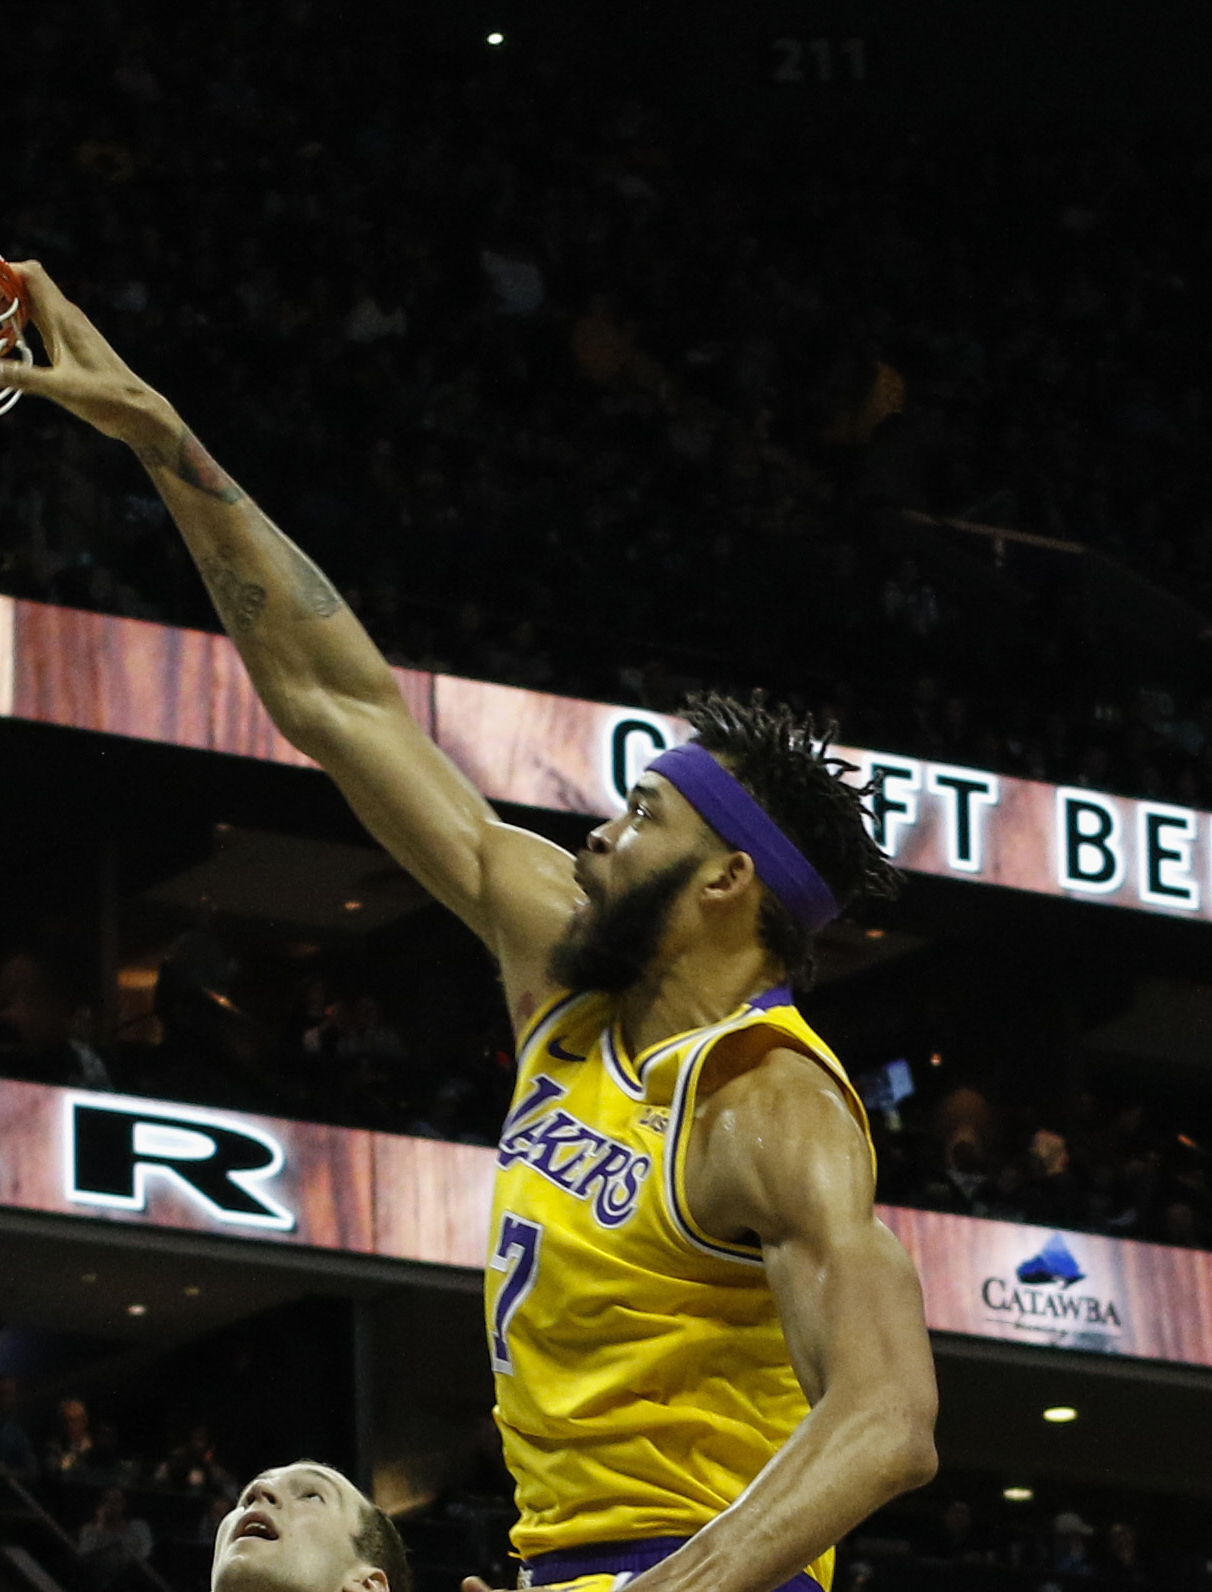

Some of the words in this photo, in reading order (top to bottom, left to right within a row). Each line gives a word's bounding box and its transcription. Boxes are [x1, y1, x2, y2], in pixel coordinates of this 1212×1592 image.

[771, 37, 866, 82] 211
[496, 1074, 651, 1230] LAKERS
[489, 1210, 544, 1376] 7
[981, 1276, 1122, 1327] CATAWBA
